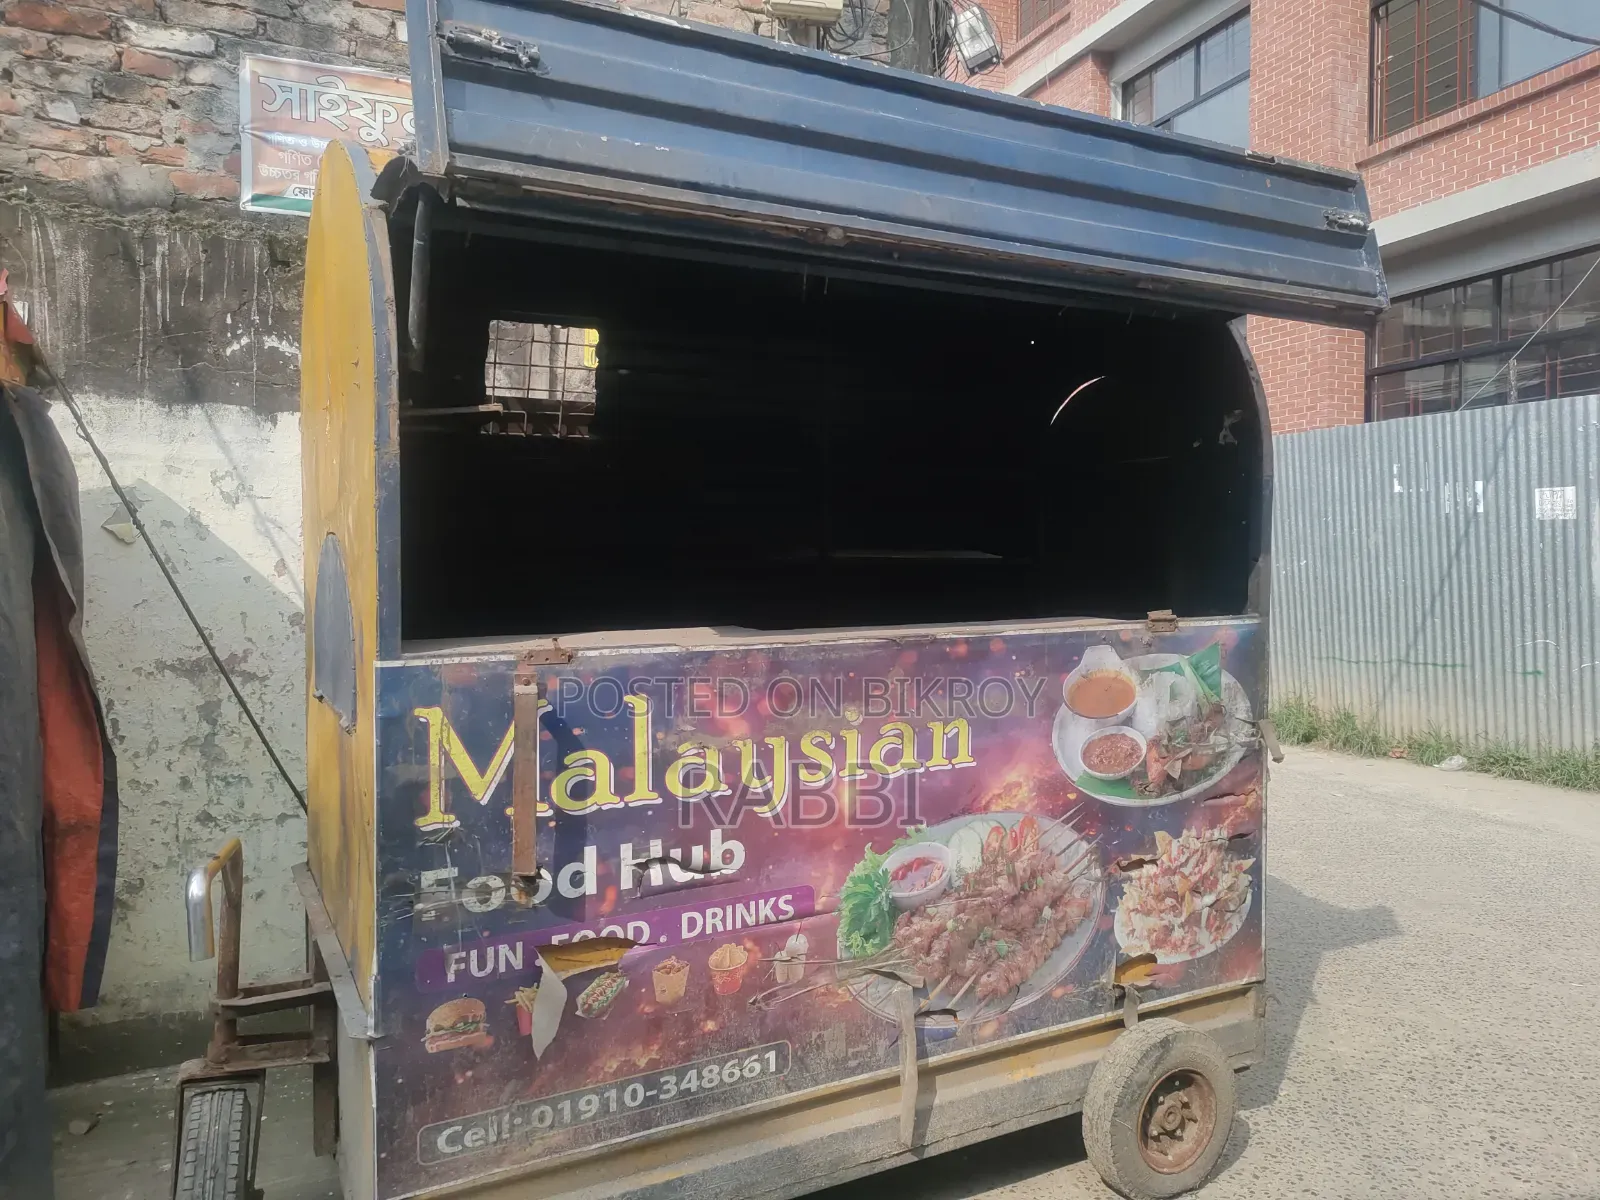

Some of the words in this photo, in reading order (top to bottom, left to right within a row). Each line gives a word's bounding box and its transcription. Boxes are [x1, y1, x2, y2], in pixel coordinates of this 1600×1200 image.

[278, 149, 313, 166] গণিত
[292, 186, 316, 199] ফো
[413, 692, 977, 830] Malaysian
[619, 828, 746, 891] Hub
[446, 941, 524, 983] FUN
[680, 894, 795, 940] DRINKS
[531, 1049, 777, 1129] 01910-348661
